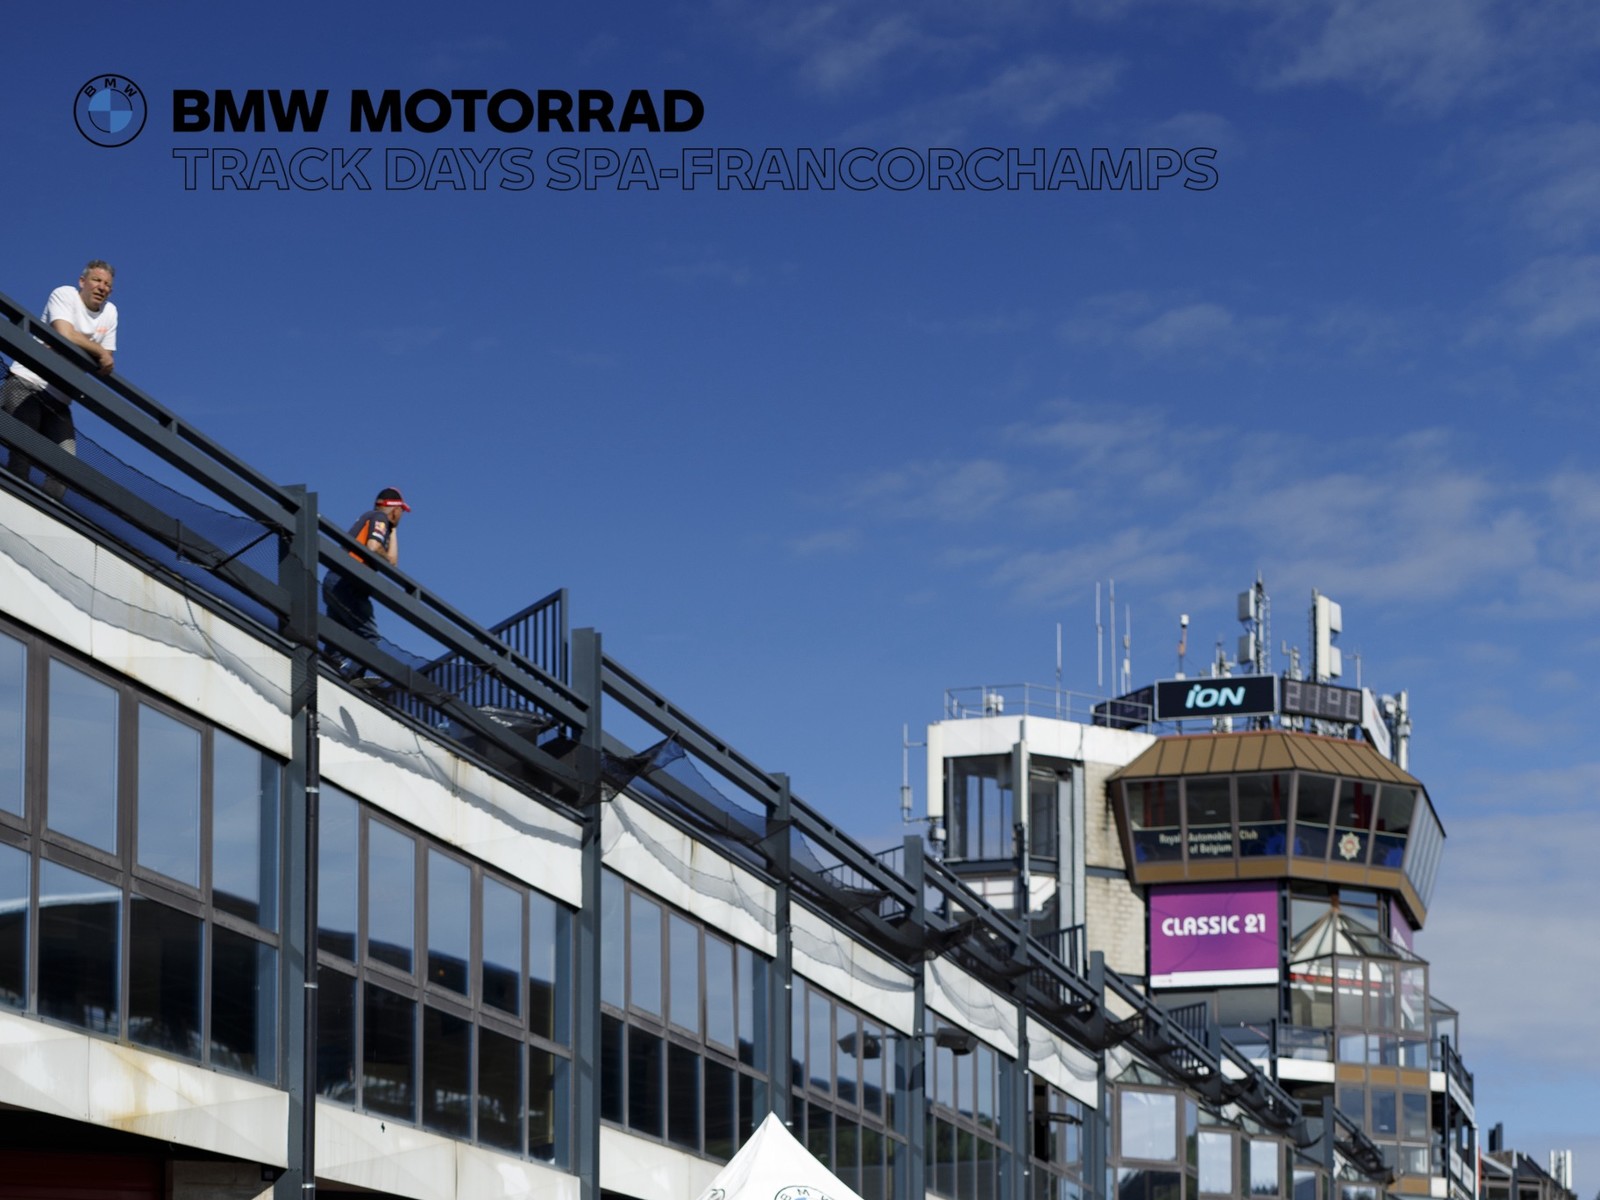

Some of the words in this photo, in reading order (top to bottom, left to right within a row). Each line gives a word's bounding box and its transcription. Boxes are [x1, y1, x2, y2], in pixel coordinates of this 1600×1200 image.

[1159, 833, 1181, 846] Royal
[1189, 831, 1233, 842] Automobile
[1239, 829, 1258, 841] Club
[1189, 844, 1199, 854] of
[1200, 843, 1232, 855] Belgium
[1161, 915, 1240, 937] CLASSIC
[1244, 913, 1266, 934] 21
